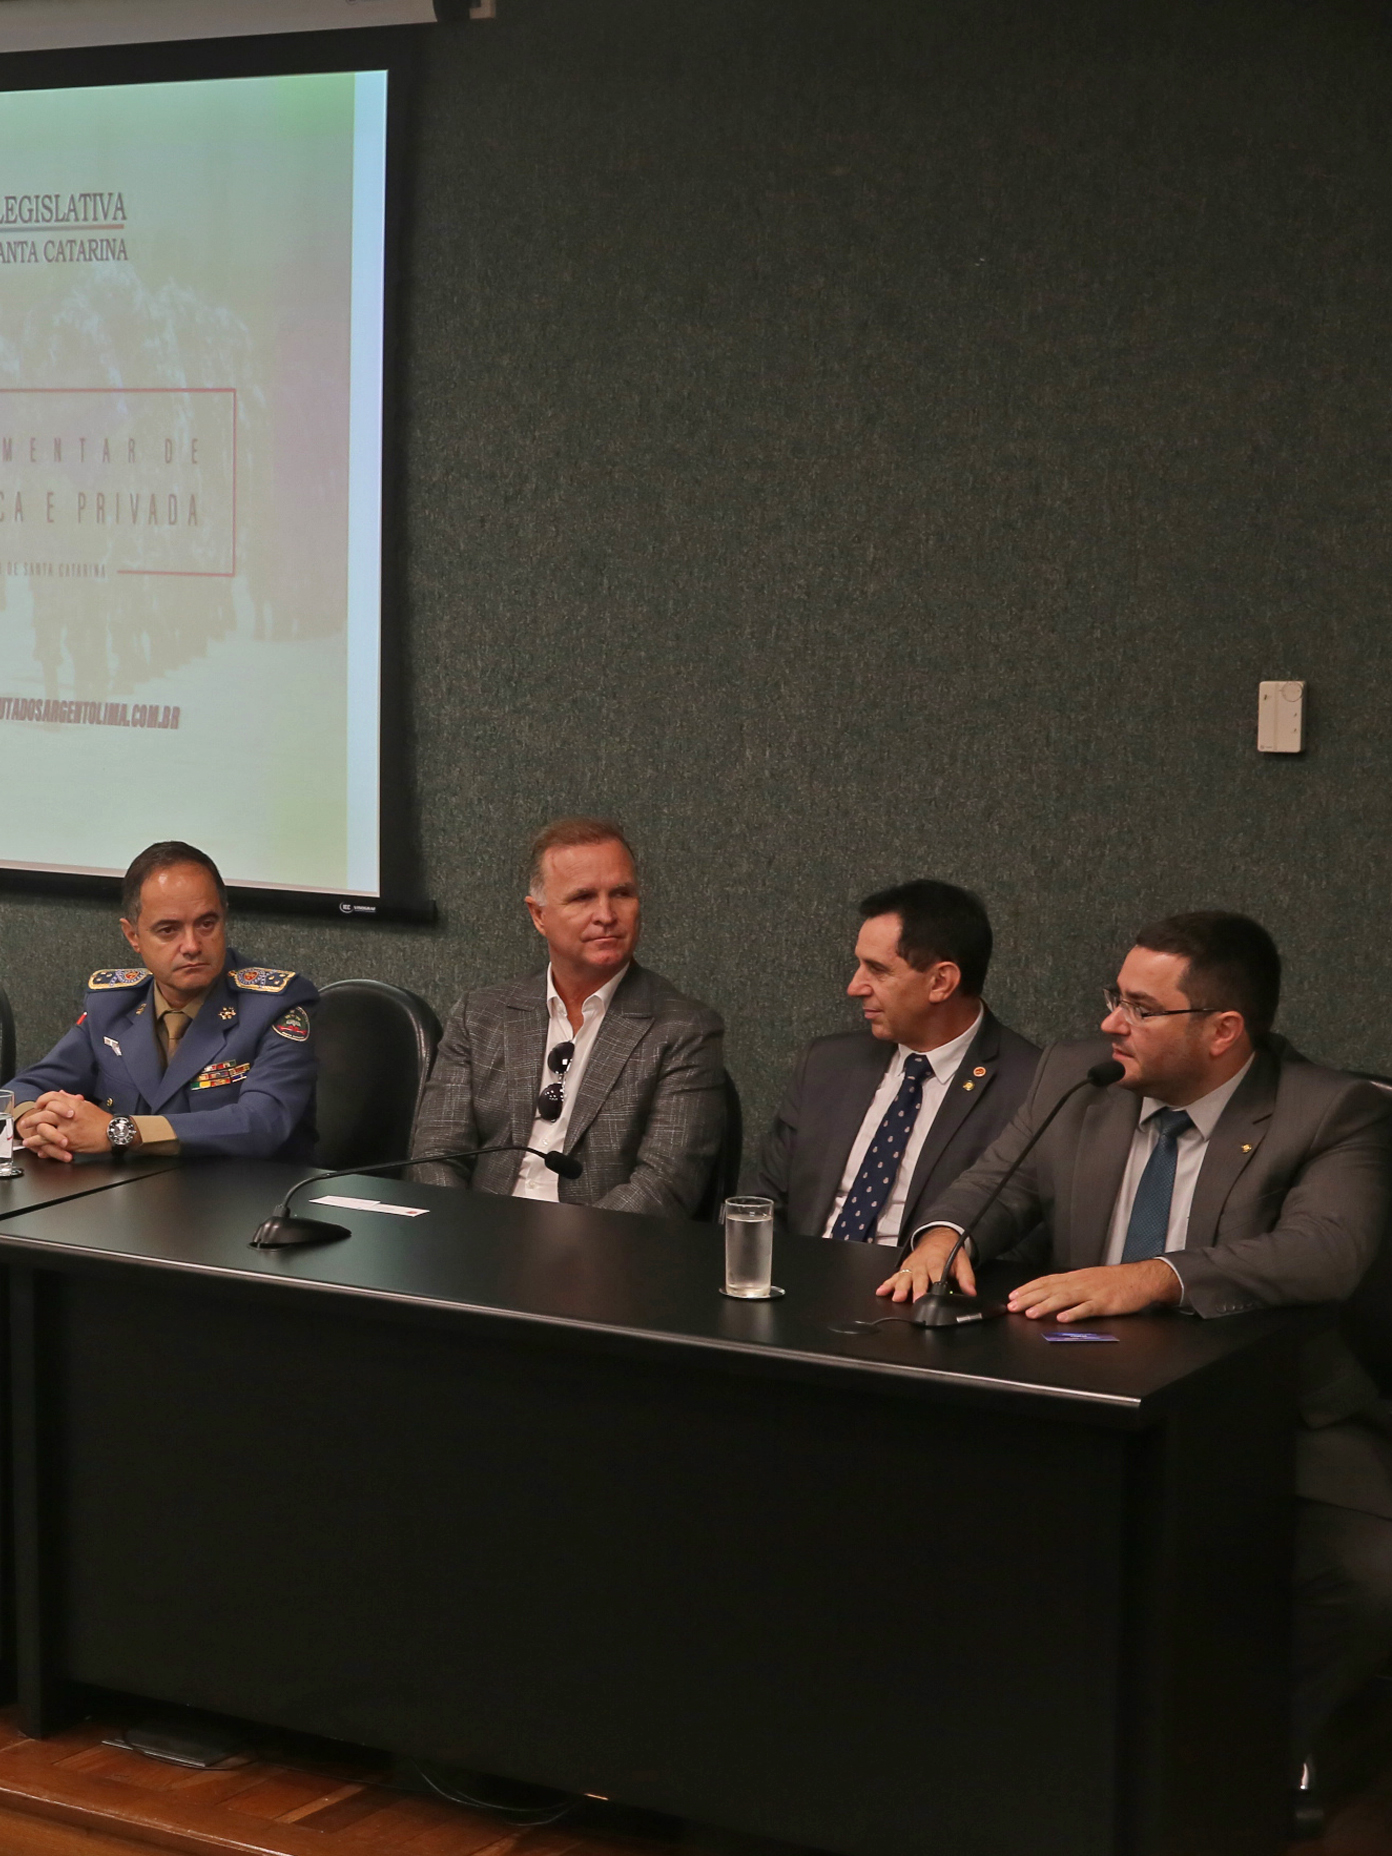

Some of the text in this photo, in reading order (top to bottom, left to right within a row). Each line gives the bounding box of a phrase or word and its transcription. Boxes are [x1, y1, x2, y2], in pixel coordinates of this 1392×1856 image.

[43, 238, 128, 263] CATARINA
[165, 438, 198, 465] DE
[46, 491, 55, 523] E
[77, 492, 198, 526] PRIVADA
